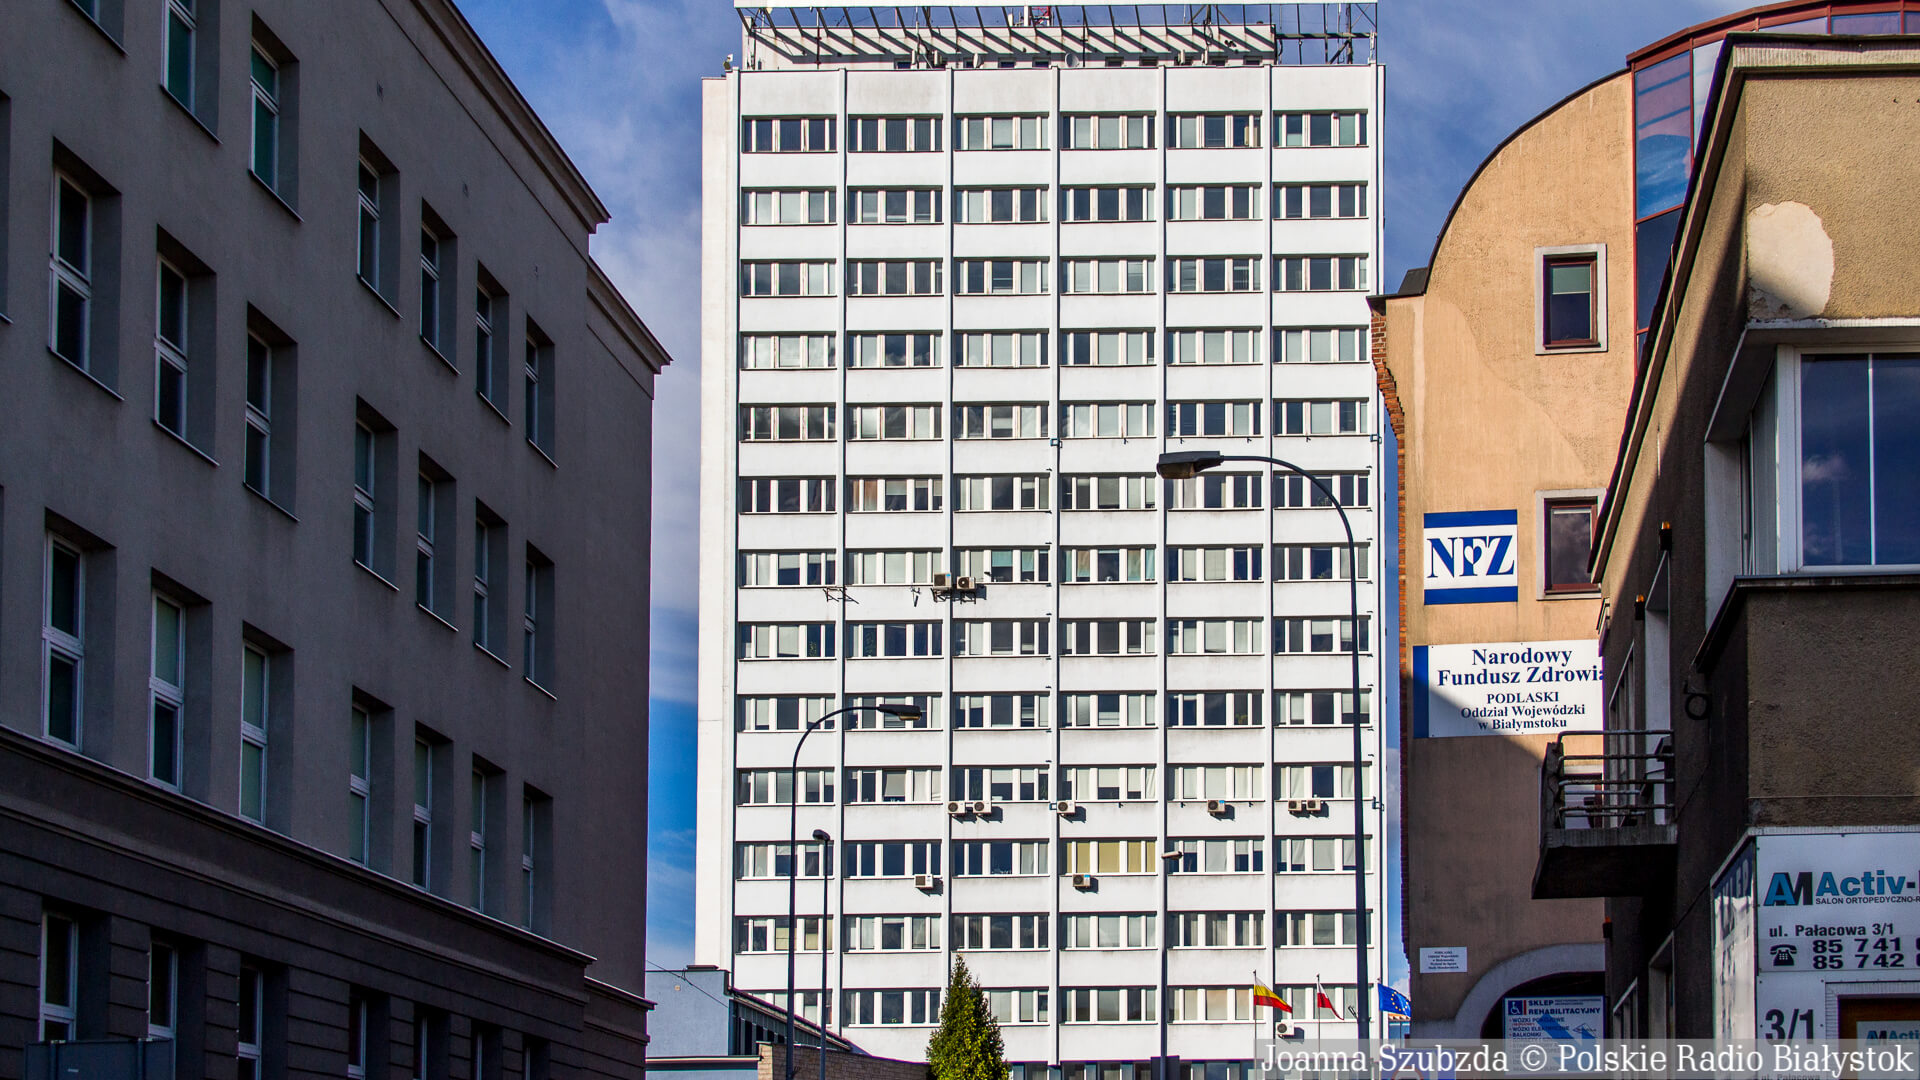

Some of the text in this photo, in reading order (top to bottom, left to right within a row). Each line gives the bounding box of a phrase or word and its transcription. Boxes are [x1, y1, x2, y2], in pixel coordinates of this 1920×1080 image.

[1427, 535, 1515, 578] NFZ
[1472, 648, 1572, 667] Narodowy
[1437, 668, 1521, 686] Fundusz
[1486, 691, 1560, 704] PODLASKI
[1460, 704, 1586, 719] Oddział Wojewódzki
[1479, 717, 1568, 731] w Białymstoku
[1815, 897, 1844, 905] SALON
[1769, 923, 1894, 937] ul. Pałacowa 3/1
[1812, 939, 1843, 953] 85
[1854, 937, 1902, 952] 741
[1812, 954, 1844, 970] 85
[1854, 953, 1905, 968] 742
[1528, 1007, 1601, 1015] REHABILITACYJNY
[1765, 1008, 1814, 1046] 3/1
